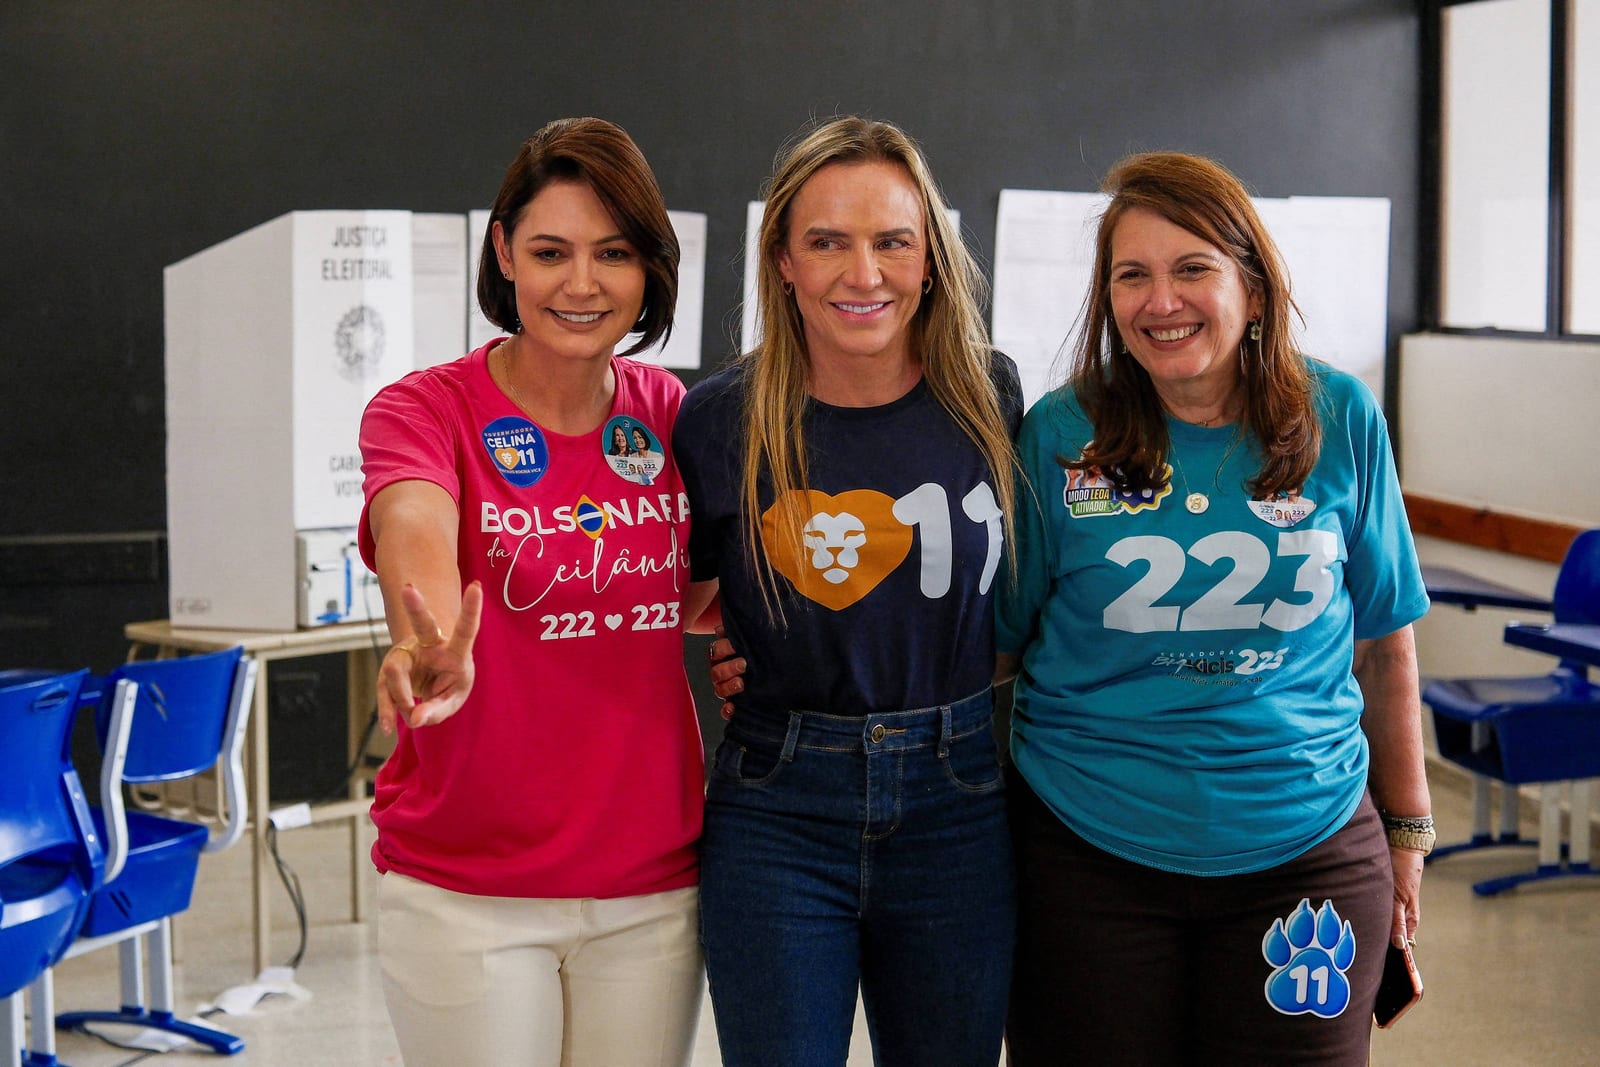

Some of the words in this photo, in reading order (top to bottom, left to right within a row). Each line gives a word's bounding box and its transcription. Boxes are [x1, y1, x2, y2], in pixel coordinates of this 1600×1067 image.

[322, 258, 394, 280] ELEITORAL
[487, 433, 536, 448] CELINA
[517, 448, 536, 466] 11
[1068, 489, 1089, 502] MODO
[1090, 488, 1110, 501] LEOA
[1075, 500, 1107, 515] ATIVADO!
[487, 537, 511, 568] da
[892, 481, 1004, 599] 11
[1103, 531, 1338, 633] 223
[539, 611, 596, 641] 222
[631, 602, 680, 631] 223
[1289, 964, 1329, 1005] 11
